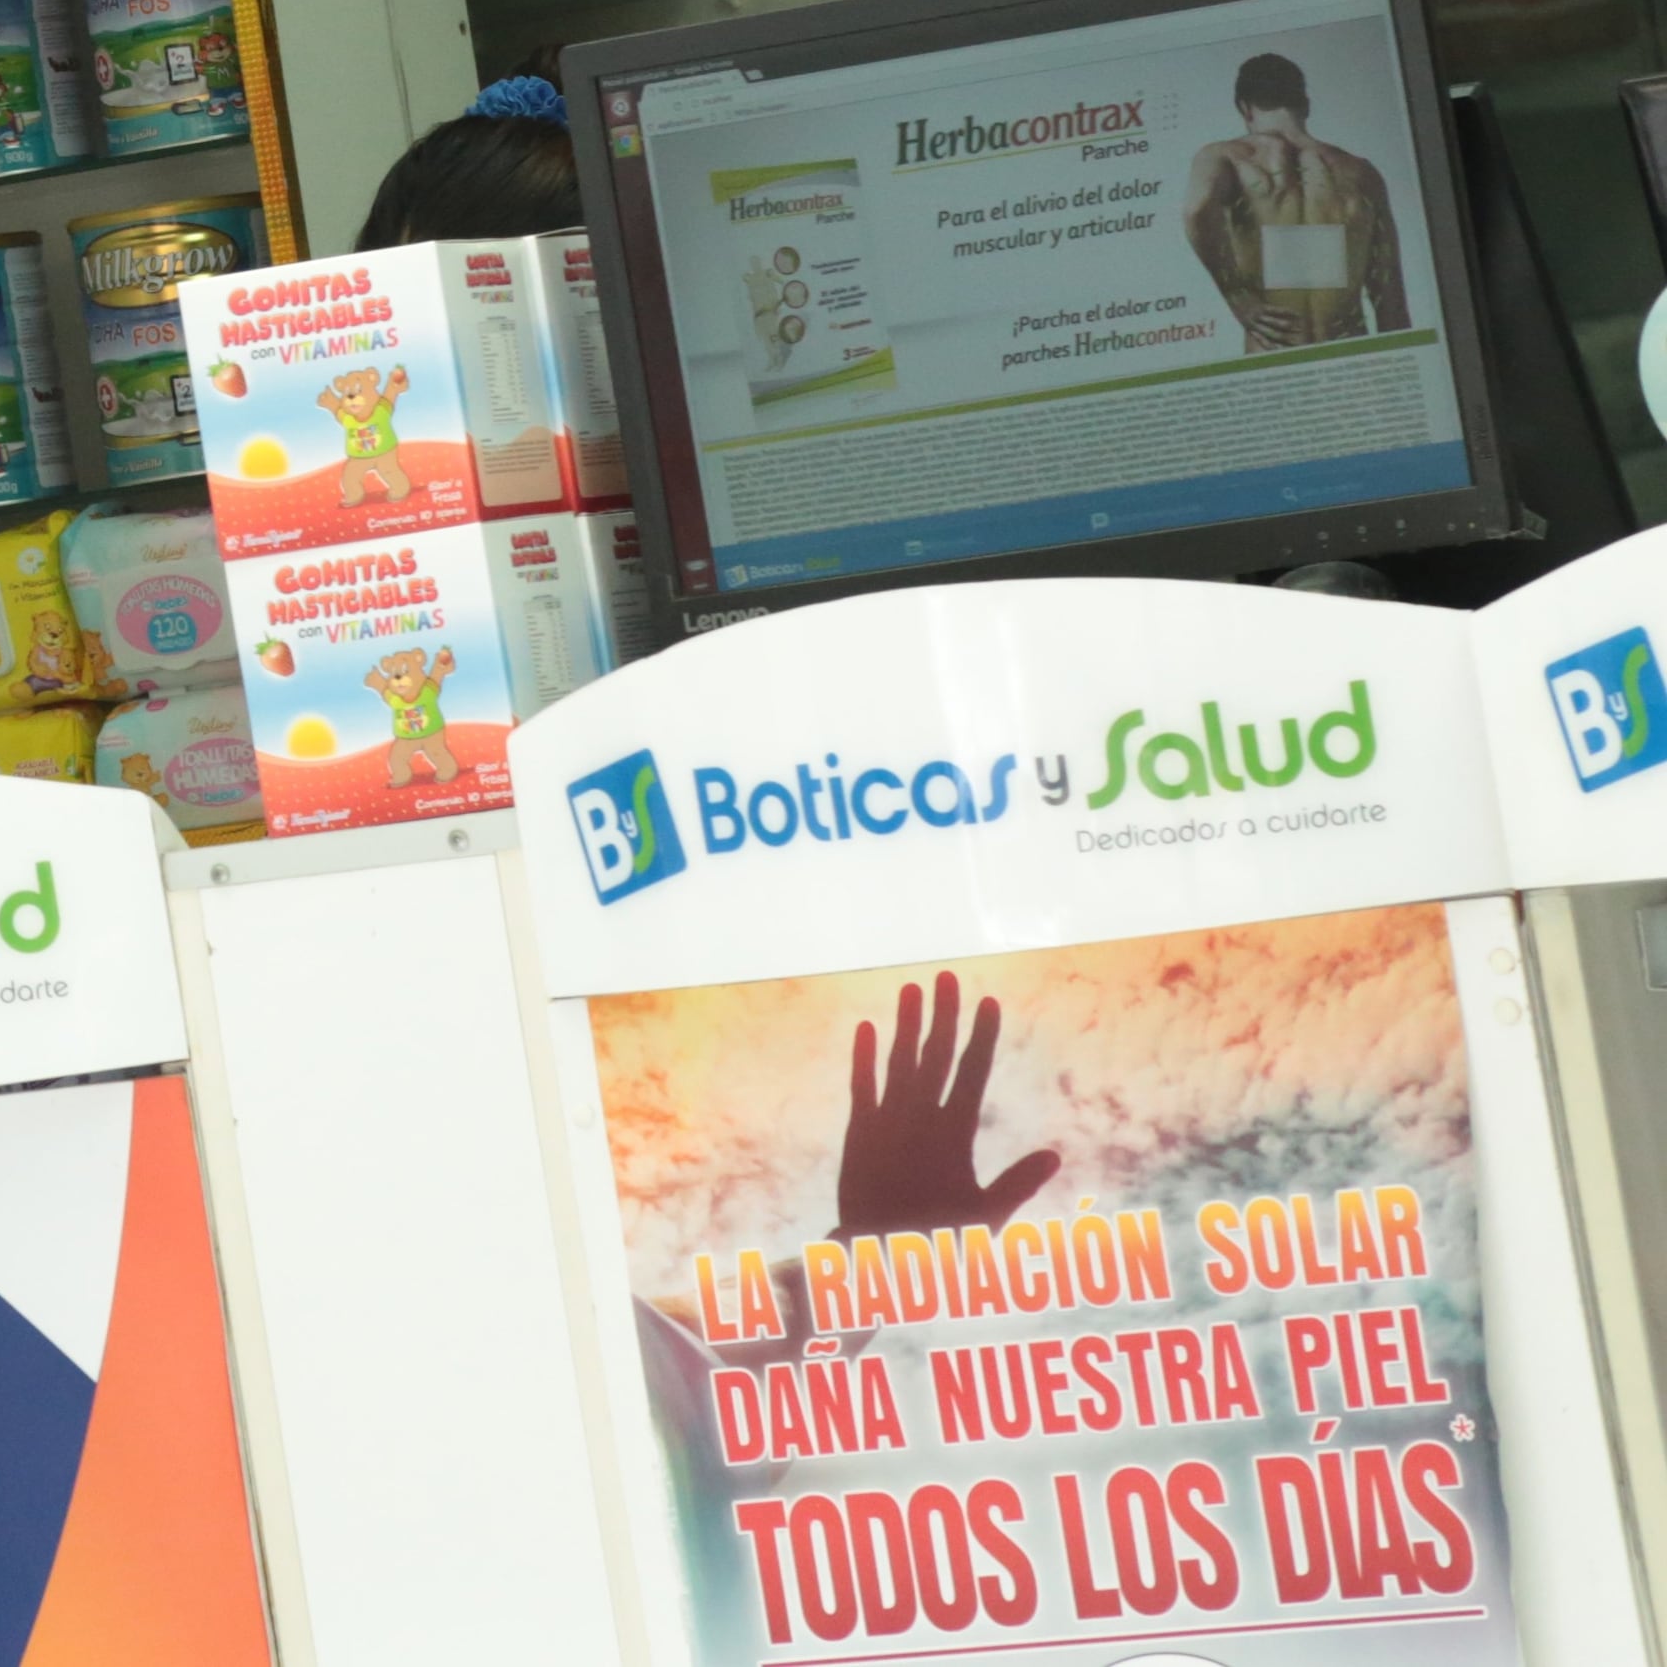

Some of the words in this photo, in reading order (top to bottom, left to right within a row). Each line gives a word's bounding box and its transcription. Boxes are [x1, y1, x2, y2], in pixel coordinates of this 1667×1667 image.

[895, 98, 1145, 166] Herbacontrax
[1082, 138, 1149, 162] Parche
[937, 208, 985, 229] Para
[990, 205, 1007, 221] el
[1013, 192, 1067, 217] alivio
[1072, 185, 1102, 208] del
[1109, 177, 1162, 203] dolor
[228, 268, 372, 316] GOMITAS
[220, 298, 393, 348] MASTICABLES
[250, 344, 276, 360] con
[279, 327, 399, 366] VITAMINAS
[696, 751, 1014, 857] Boticas
[1036, 750, 1067, 806] y
[1086, 679, 1377, 810] Salud
[695, 1249, 782, 1345] LA
[805, 1196, 1171, 1336] RADIACIÓN
[1198, 1185, 1429, 1296] SOLAR
[710, 1340, 906, 1466] DAÑA
[930, 1322, 1259, 1445] NUESTRA
[1285, 1306, 1449, 1416] PIEL
[735, 1479, 1038, 1648] TODOS
[1054, 1460, 1240, 1623] LOS
